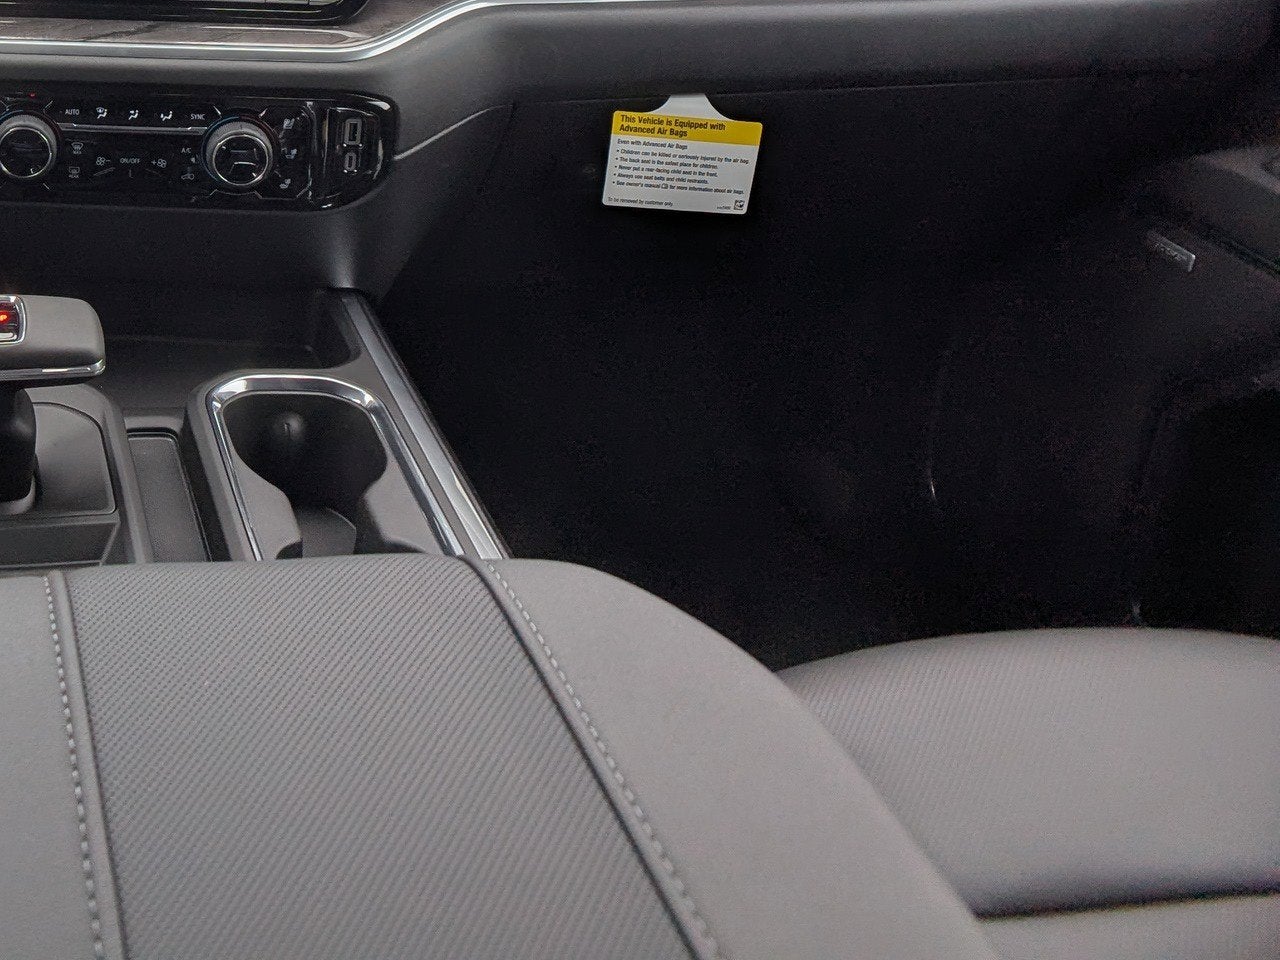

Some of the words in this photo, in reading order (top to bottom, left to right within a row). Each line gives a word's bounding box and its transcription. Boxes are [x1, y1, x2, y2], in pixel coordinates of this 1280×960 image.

[65, 108, 80, 116] AUTO
[190, 113, 206, 121] SYNC
[621, 114, 636, 123] This
[638, 116, 664, 126] Vehicle
[666, 119, 673, 127] is
[674, 119, 708, 130] Equipped
[710, 122, 726, 131] with
[620, 124, 655, 135] Advanced
[656, 127, 668, 135] Air
[669, 128, 688, 138] Bags
[642, 140, 666, 148] Advanced
[620, 148, 641, 156] Children
